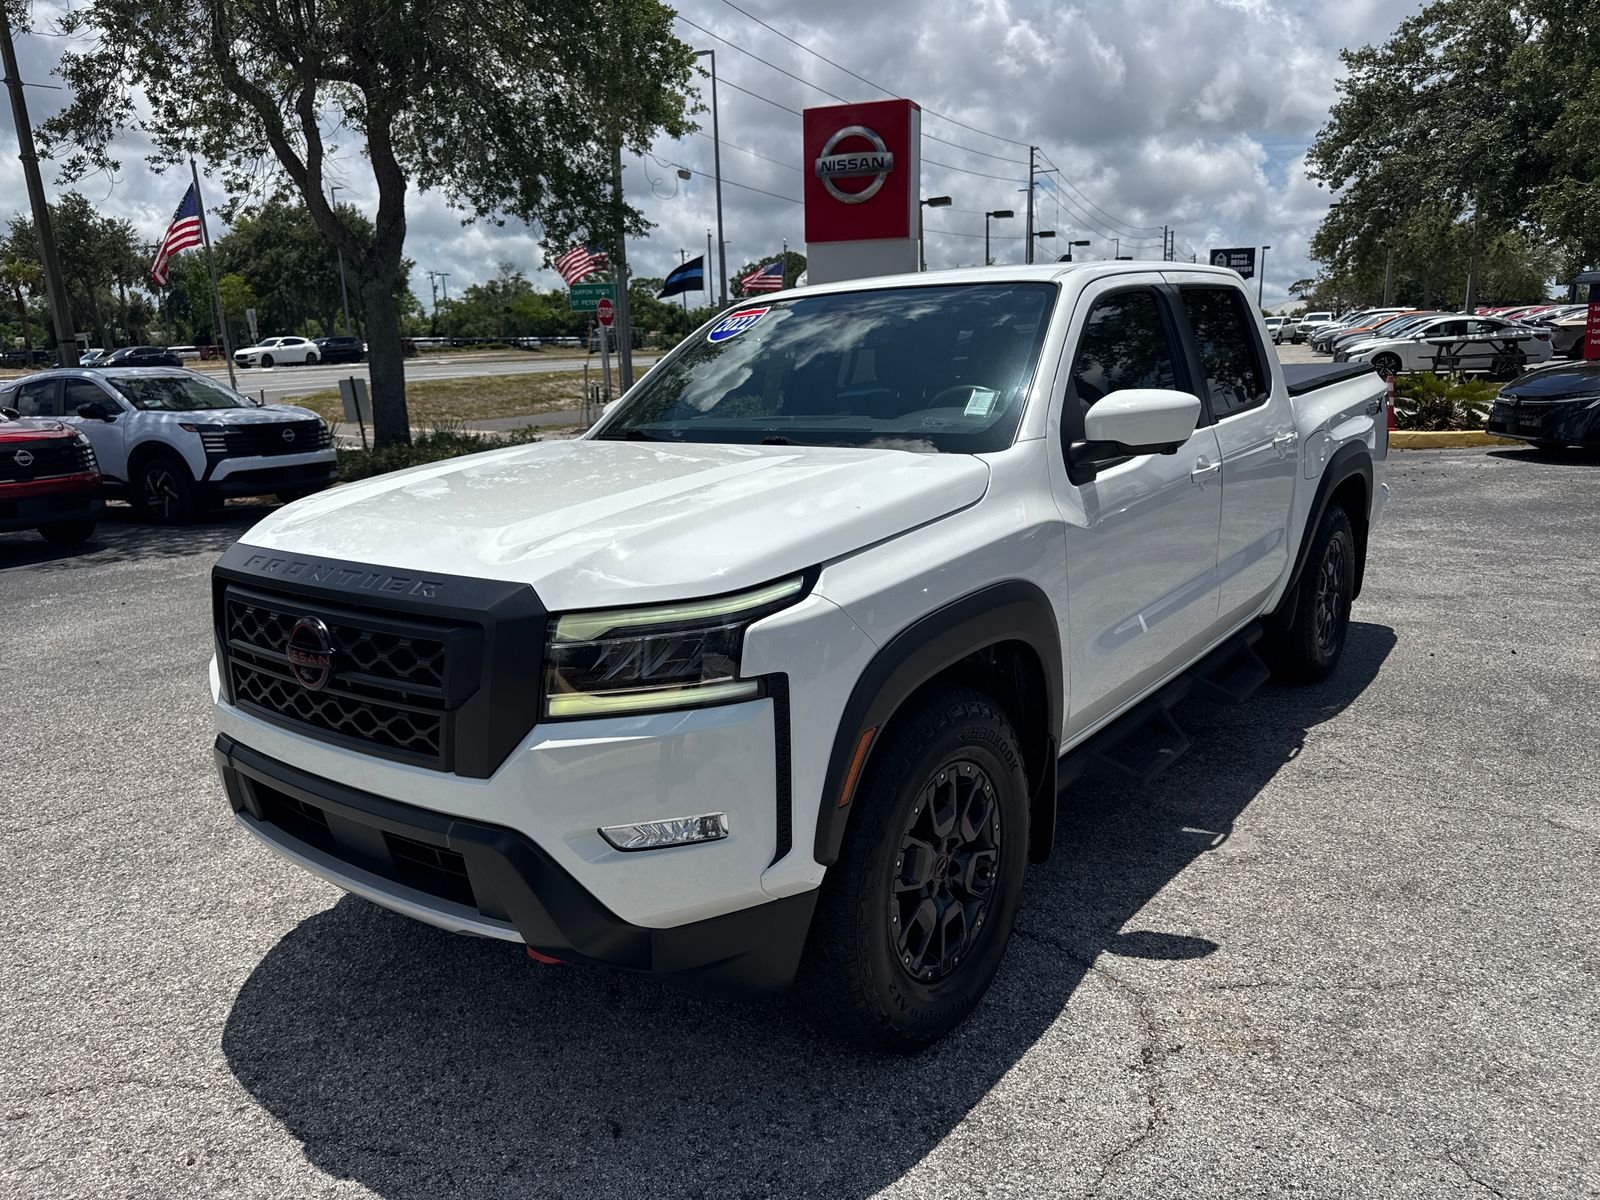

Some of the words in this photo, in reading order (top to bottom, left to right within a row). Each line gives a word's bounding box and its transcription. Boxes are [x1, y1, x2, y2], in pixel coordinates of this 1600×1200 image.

[821, 156, 885, 173] NISSAN
[571, 288, 594, 296] TARPON
[598, 307, 613, 318] STOP
[713, 315, 757, 334] 2022
[243, 554, 444, 598] FRONTIER
